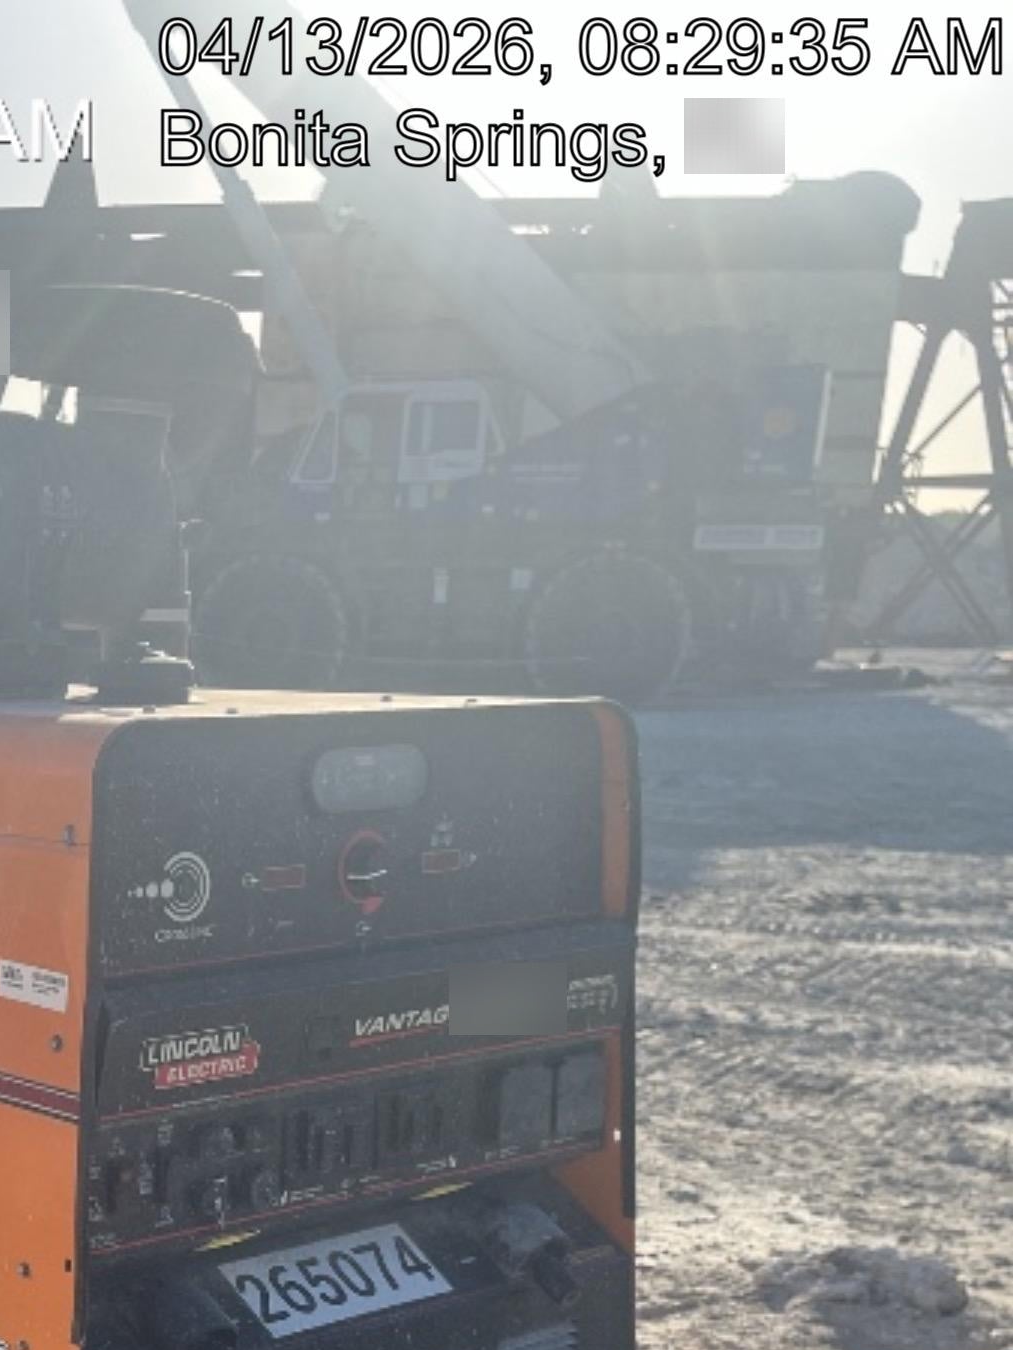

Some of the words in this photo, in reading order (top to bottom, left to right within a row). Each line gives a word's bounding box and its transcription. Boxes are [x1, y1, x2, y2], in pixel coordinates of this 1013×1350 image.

[354, 1003, 450, 1037] VANTAG
[147, 1031, 241, 1065] LINCOLN
[235, 1235, 435, 1324] 265074
